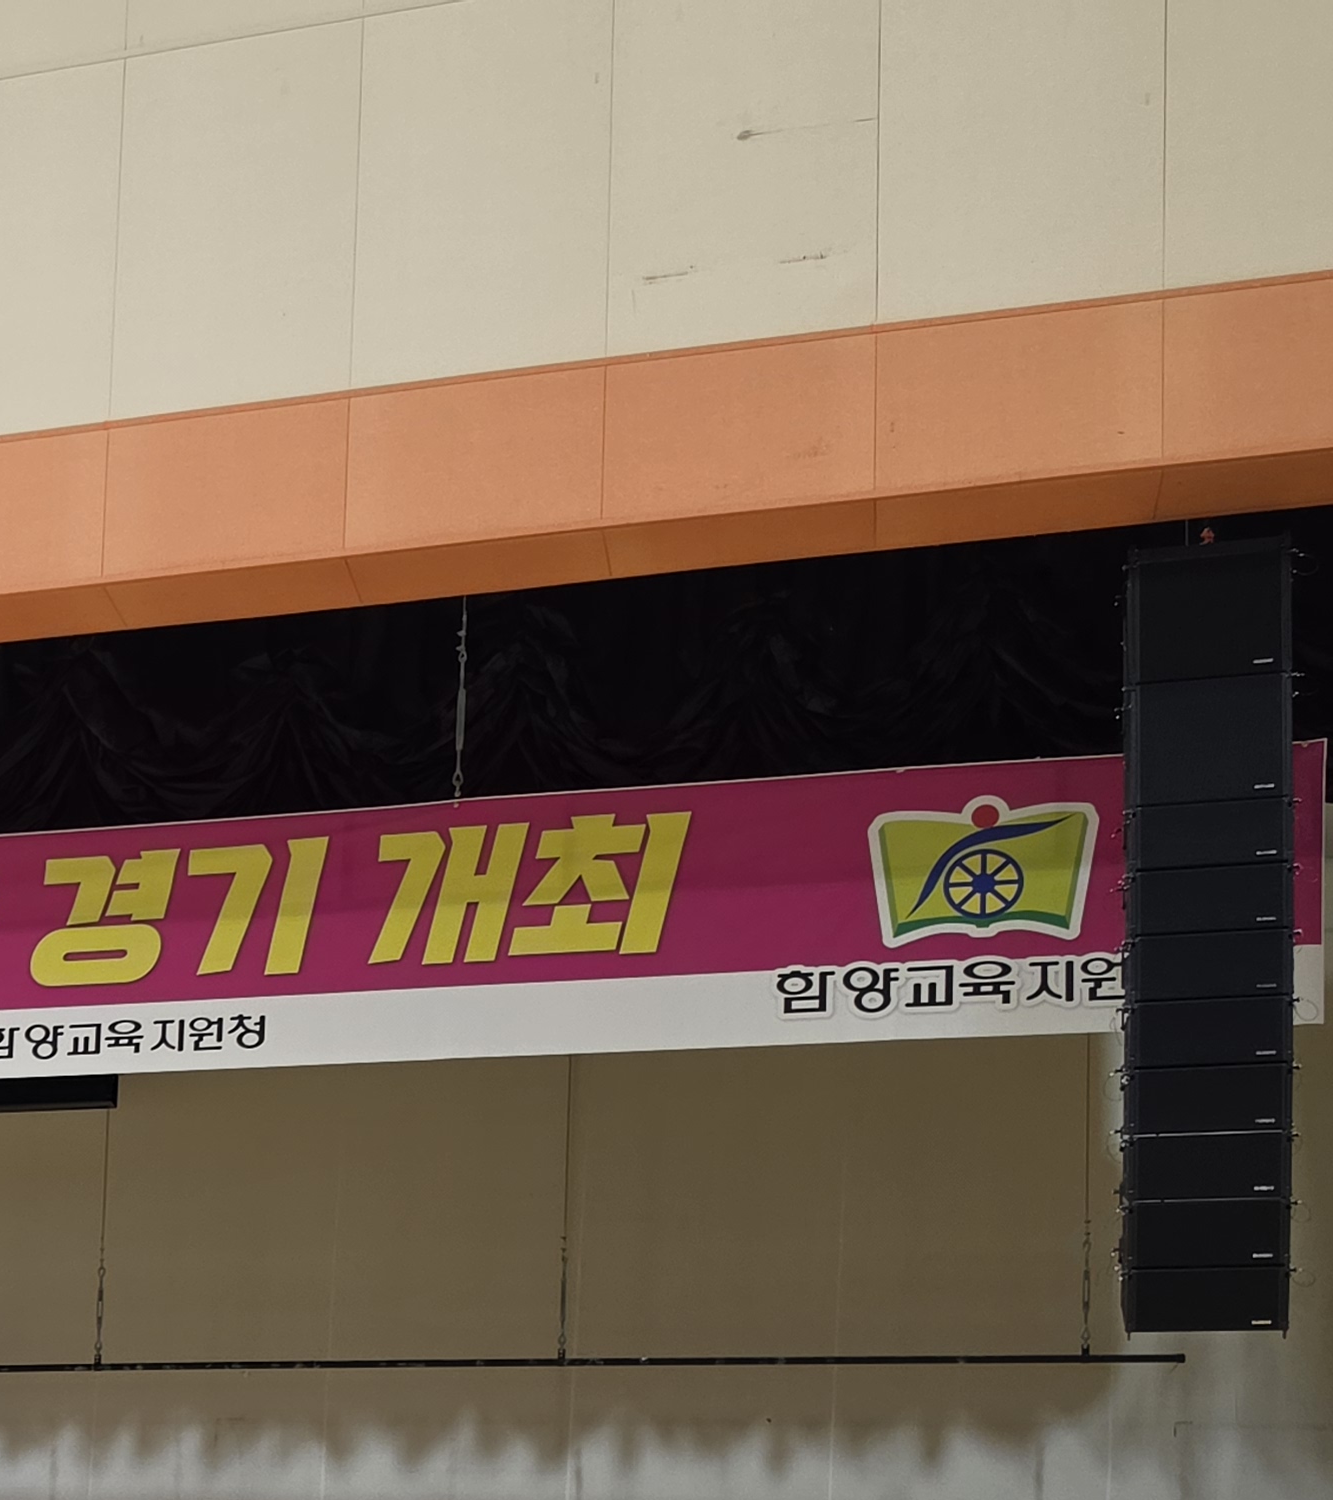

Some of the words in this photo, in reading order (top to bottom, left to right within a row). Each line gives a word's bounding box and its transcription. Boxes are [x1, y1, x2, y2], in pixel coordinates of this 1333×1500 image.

[29, 835, 329, 988] 경기
[366, 810, 691, 965] 개최
[776, 956, 1126, 1014] 함양교육지원
